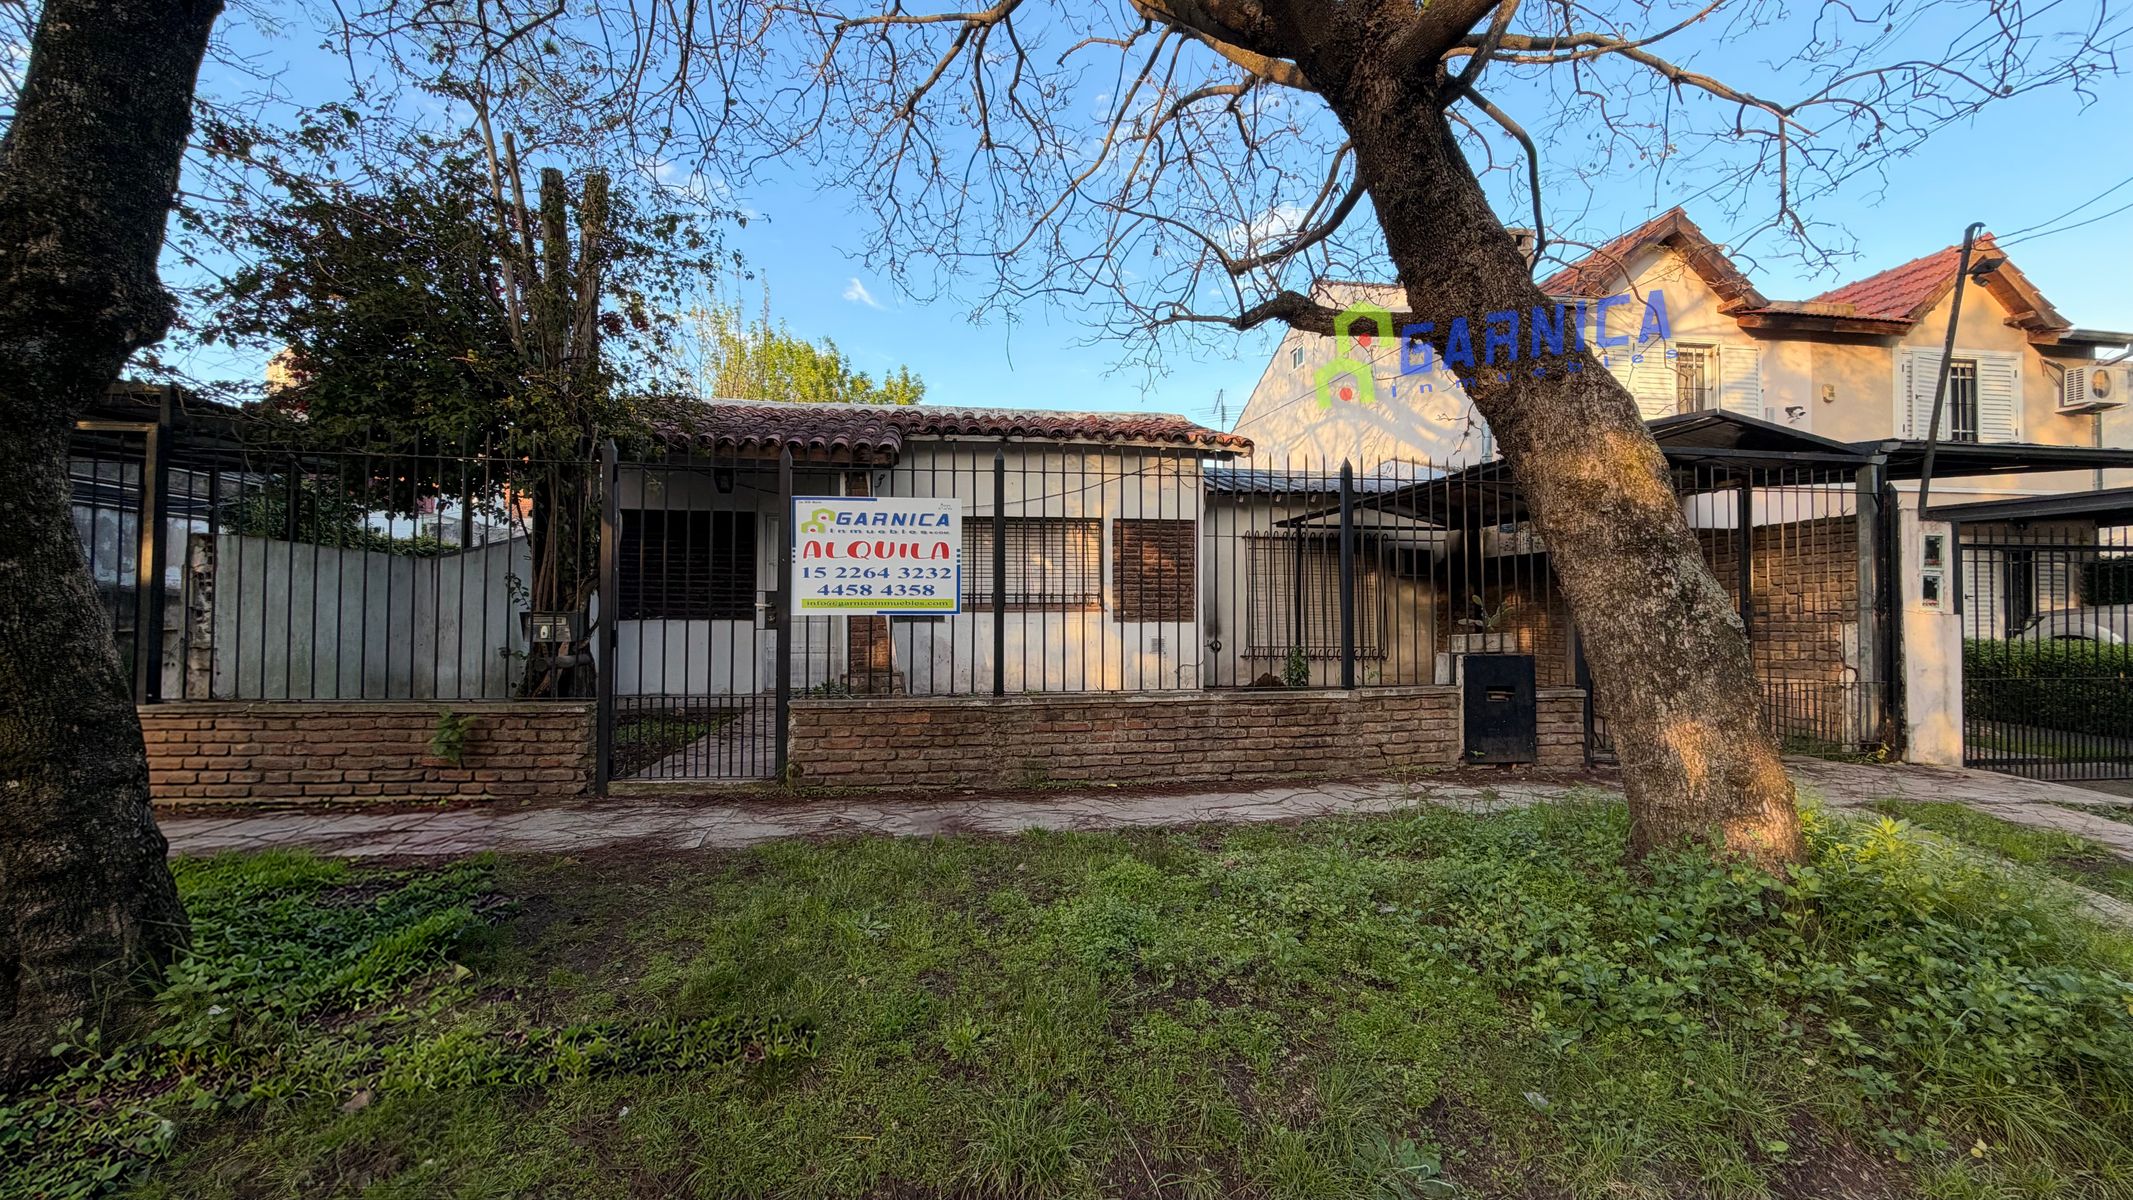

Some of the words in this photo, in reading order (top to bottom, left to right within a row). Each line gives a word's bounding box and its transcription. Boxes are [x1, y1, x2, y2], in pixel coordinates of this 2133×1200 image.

[836, 512, 950, 527] GARNICA
[802, 540, 950, 560] ALQUILA
[802, 567, 827, 579] 15
[834, 567, 890, 579] 2264
[897, 567, 952, 579] 3232
[817, 584, 873, 596] 4458
[880, 584, 935, 596] 4358
